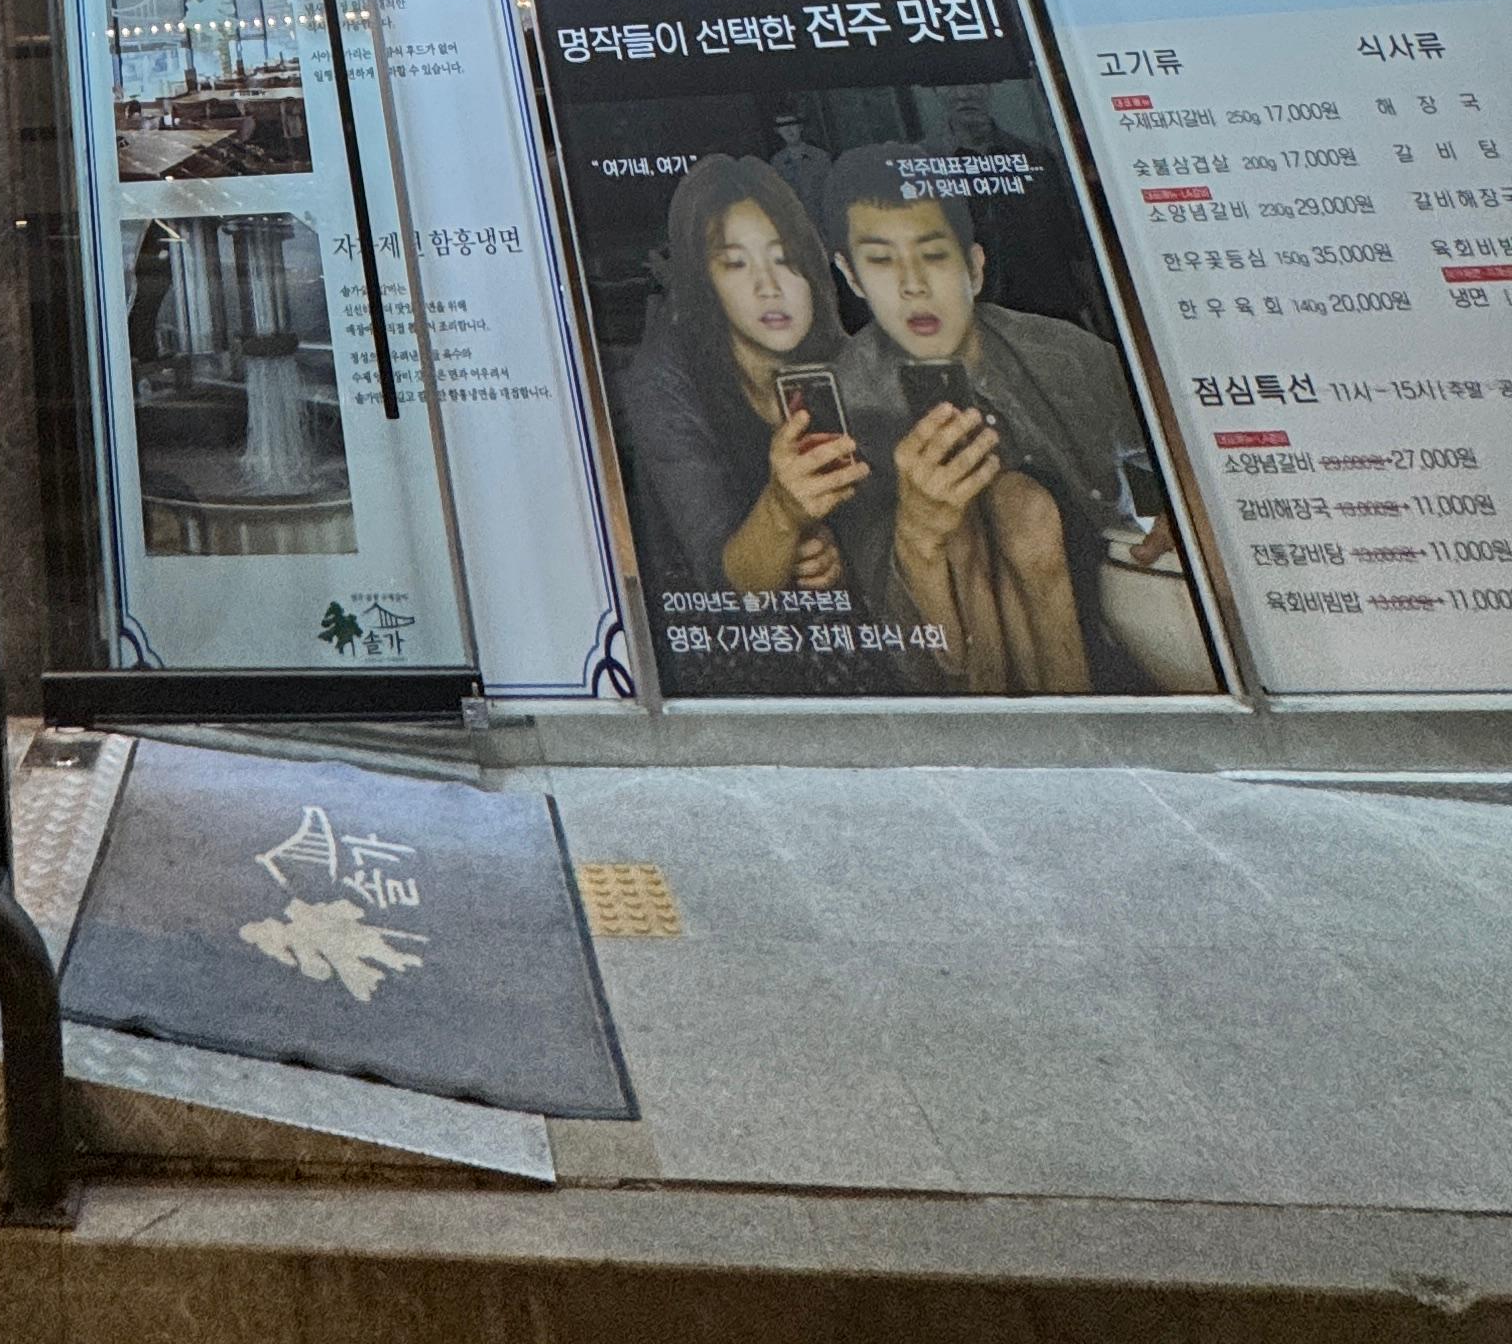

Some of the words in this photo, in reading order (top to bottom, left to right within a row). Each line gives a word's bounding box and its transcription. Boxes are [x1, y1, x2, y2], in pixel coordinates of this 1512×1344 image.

[557, 21, 689, 64] 명작들이
[695, 14, 796, 56] 선택한
[803, 1, 892, 50] 전주
[1356, 31, 1447, 63] 식사류
[1096, 48, 1184, 78] 고기류
[1119, 107, 1217, 132] 수제돼지갈비
[1226, 110, 1262, 126] 250g
[1264, 100, 1341, 124] 17,000원
[1132, 153, 1232, 178] 숯불삼겹살
[1242, 155, 1278, 172] 200g
[1281, 146, 1359, 172] 17,000원
[900, 181, 935, 201] 솔가
[1149, 200, 1250, 224] 소양념갈비
[1258, 201, 1295, 220] 230g
[1294, 193, 1377, 217] 29,000원
[428, 226, 524, 257] 함흥냉면
[1161, 247, 1267, 272] 한우꽃등심
[1312, 242, 1395, 266] 35,000원
[1329, 291, 1413, 314] 20,000원
[1449, 287, 1491, 309] 냉면
[1192, 372, 1320, 408] 점심특선
[1224, 452, 1316, 475] 소양념갈비
[1390, 446, 1480, 472] 27,000원
[1237, 497, 1333, 521] 갈비해장국
[1413, 494, 1497, 518] 11,000원
[1251, 542, 1346, 566] 전통갈비탕
[662, 590, 741, 614] 2019년도
[743, 590, 778, 613] 솔가
[782, 589, 853, 612] 전주본점
[1266, 590, 1364, 614] 육회비빔밥
[362, 629, 407, 656] 솔가
[666, 625, 712, 654] 영화
[808, 623, 855, 653] 전체
[859, 623, 906, 652] 회식
[908, 623, 949, 652] 4회
[340, 832, 420, 909] 솔가
